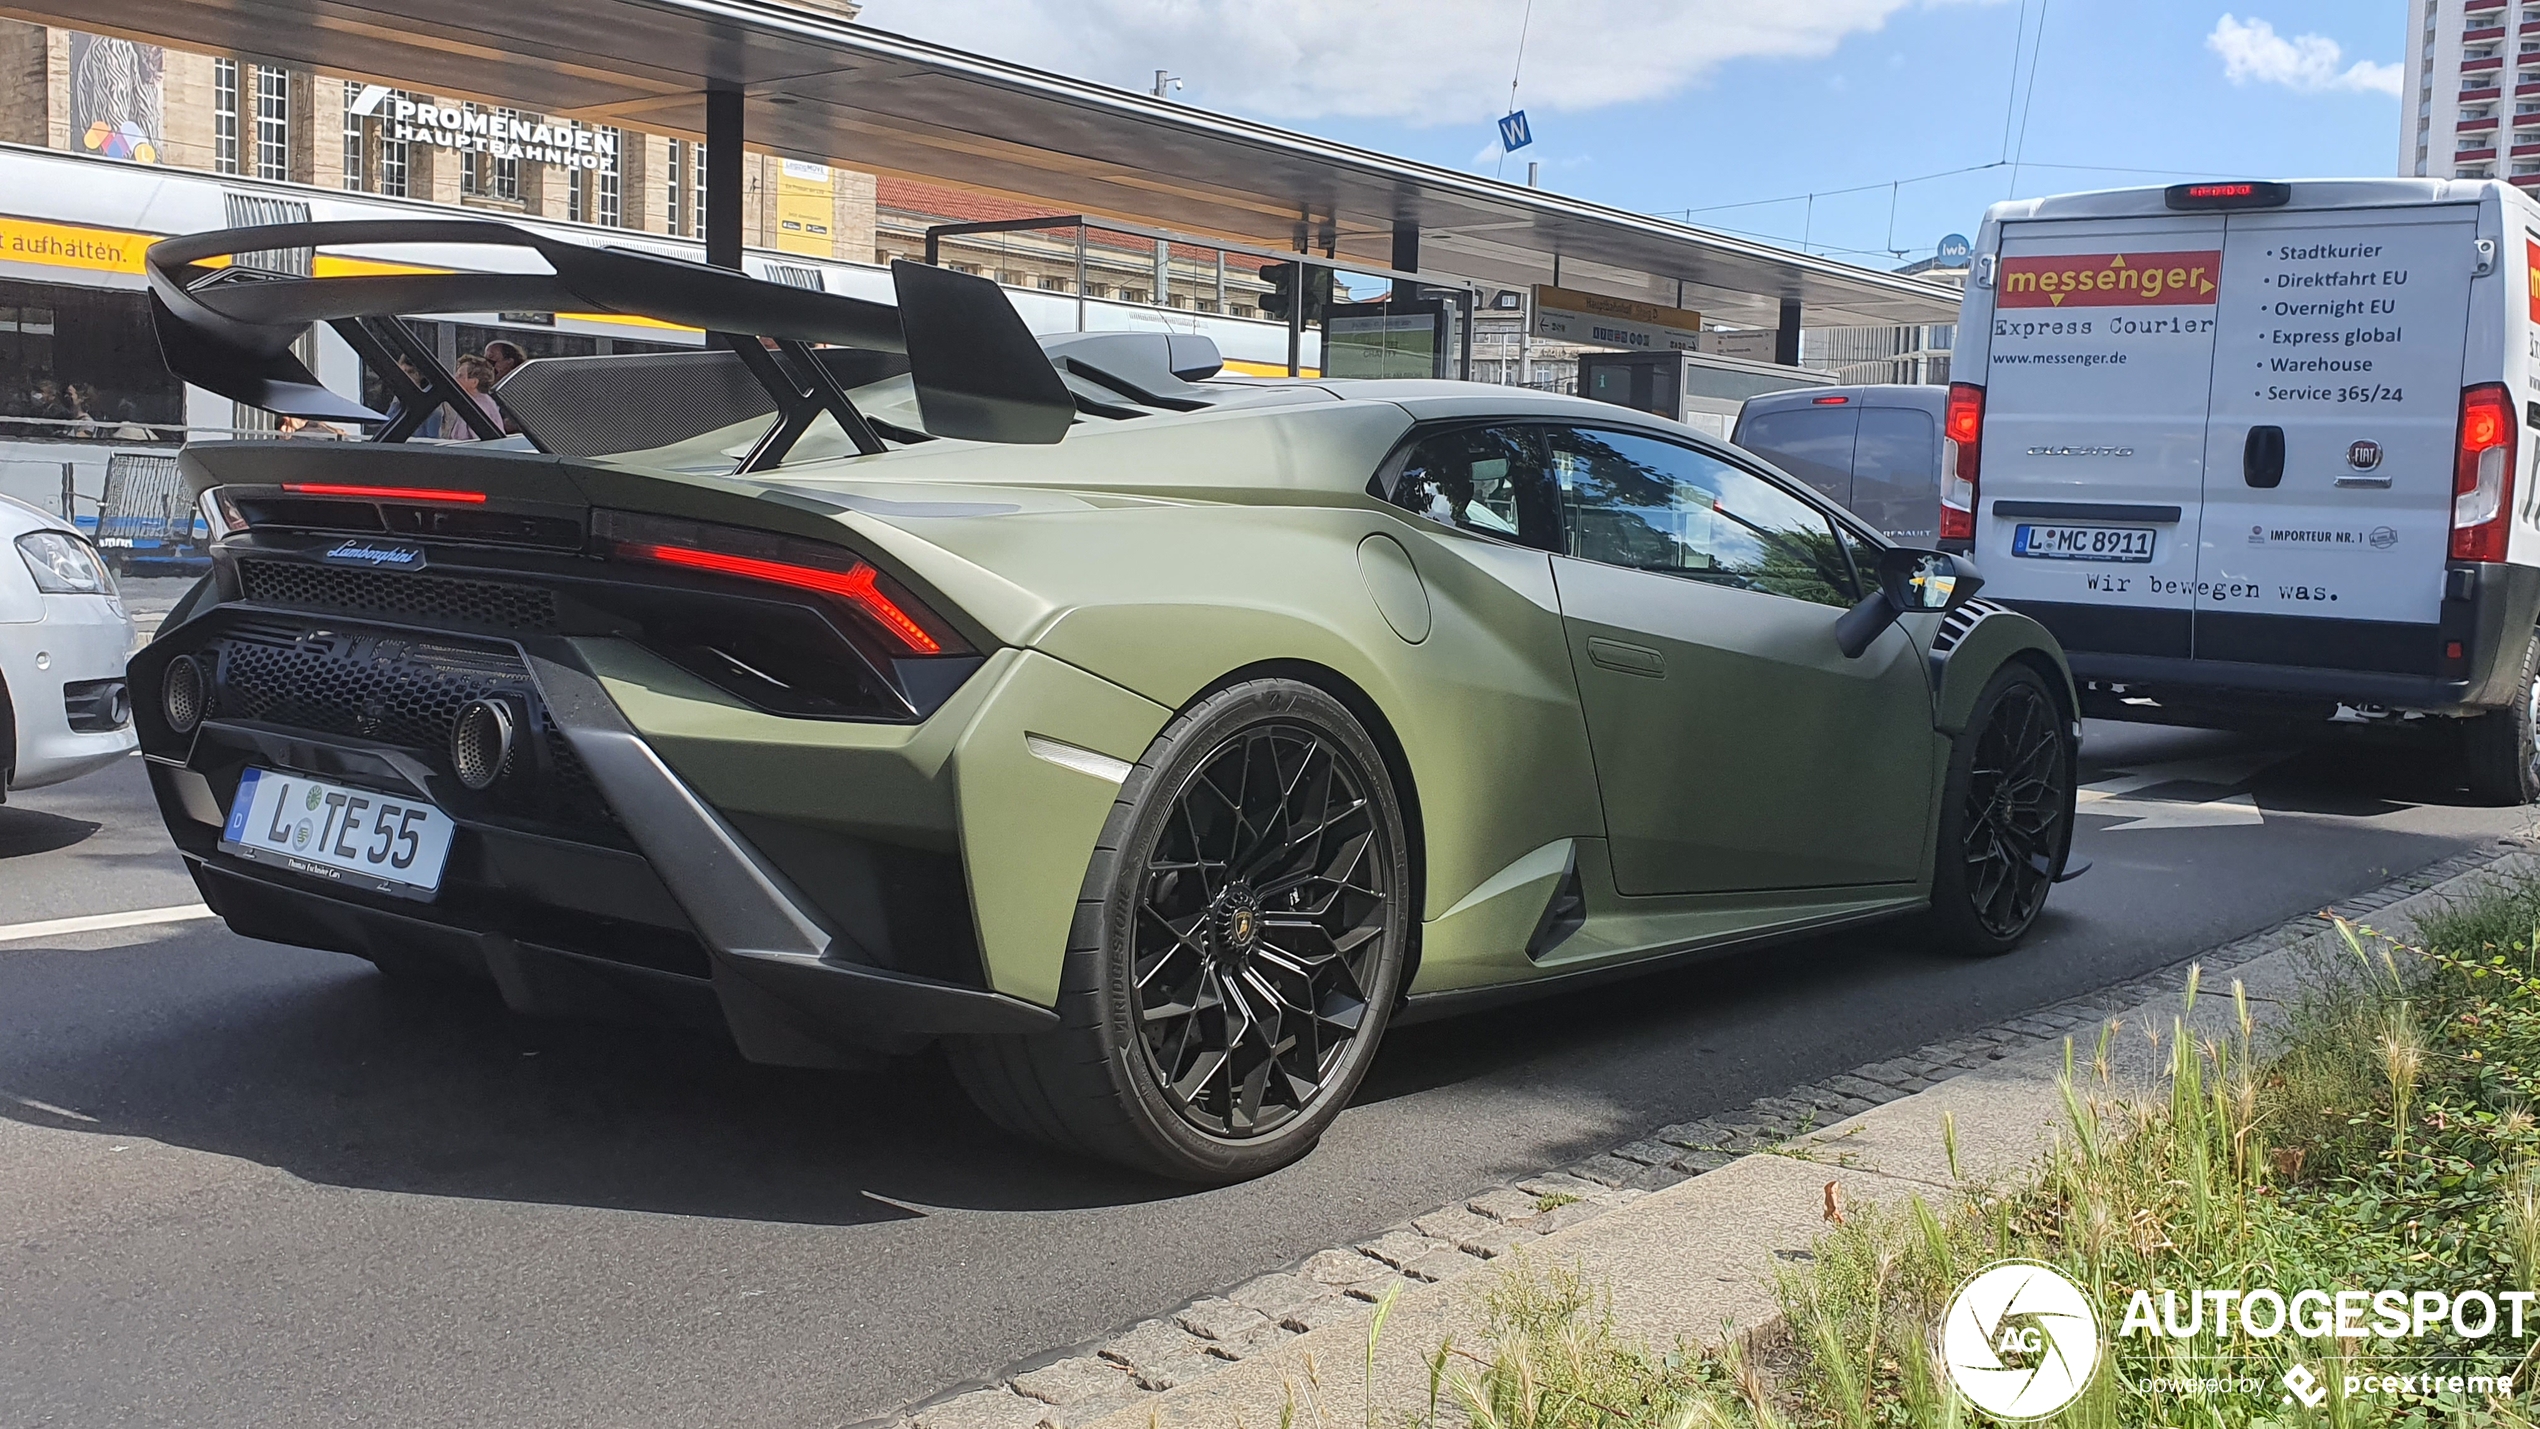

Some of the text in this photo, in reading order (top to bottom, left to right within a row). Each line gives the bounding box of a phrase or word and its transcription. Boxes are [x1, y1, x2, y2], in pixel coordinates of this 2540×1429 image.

[395, 100, 614, 155] PROMENADEN
[1501, 115, 1525, 146] W
[395, 123, 613, 170] HAUPTBAHNHOF
[12, 236, 127, 262] aufhalten.
[2279, 243, 2383, 260] Stadtkurier
[2006, 267, 2205, 298] messenger
[2277, 270, 2408, 288] Direktfahrt EU
[2274, 299, 2396, 318] Overnight EU
[1994, 316, 2214, 339] Express Courier
[2272, 327, 2402, 347] Express global
[1993, 351, 2127, 366] www.messenger.de
[2270, 357, 2373, 372] Warehouse
[2267, 383, 2403, 403] Service 365/24
[2026, 446, 2134, 456] DUCATO
[2354, 447, 2375, 463] FIAT
[2028, 528, 2148, 554] L MC 8911
[2270, 530, 2332, 542] IMPORTEUR
[2335, 533, 2355, 543] NR.
[2358, 532, 2363, 543] 1
[326, 539, 419, 565] Lamborghini
[2086, 573, 2338, 601] Wir bewegen was.
[233, 813, 243, 829] D
[268, 783, 428, 869] L TE 55
